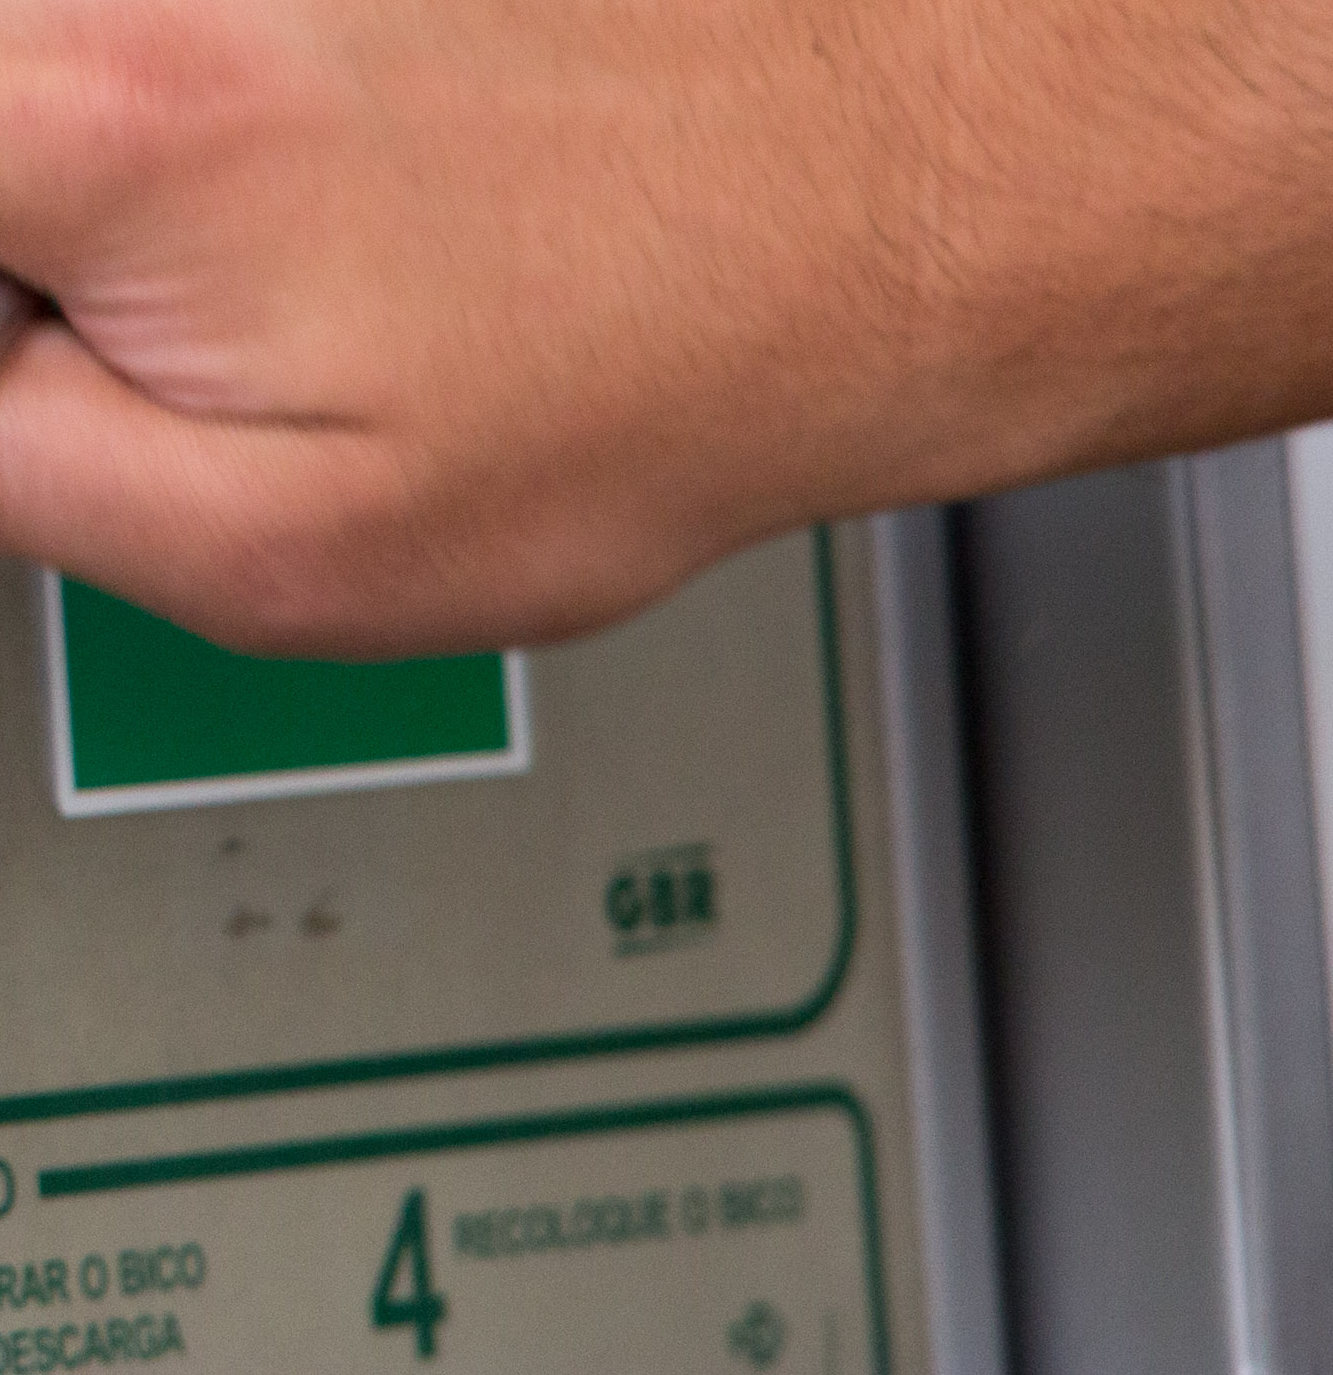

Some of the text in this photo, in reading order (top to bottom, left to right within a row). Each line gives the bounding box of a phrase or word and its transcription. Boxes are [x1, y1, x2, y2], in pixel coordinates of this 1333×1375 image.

[78, 1252, 110, 1302] O
[119, 1240, 208, 1297] BICO
[370, 1185, 447, 1362] 4
